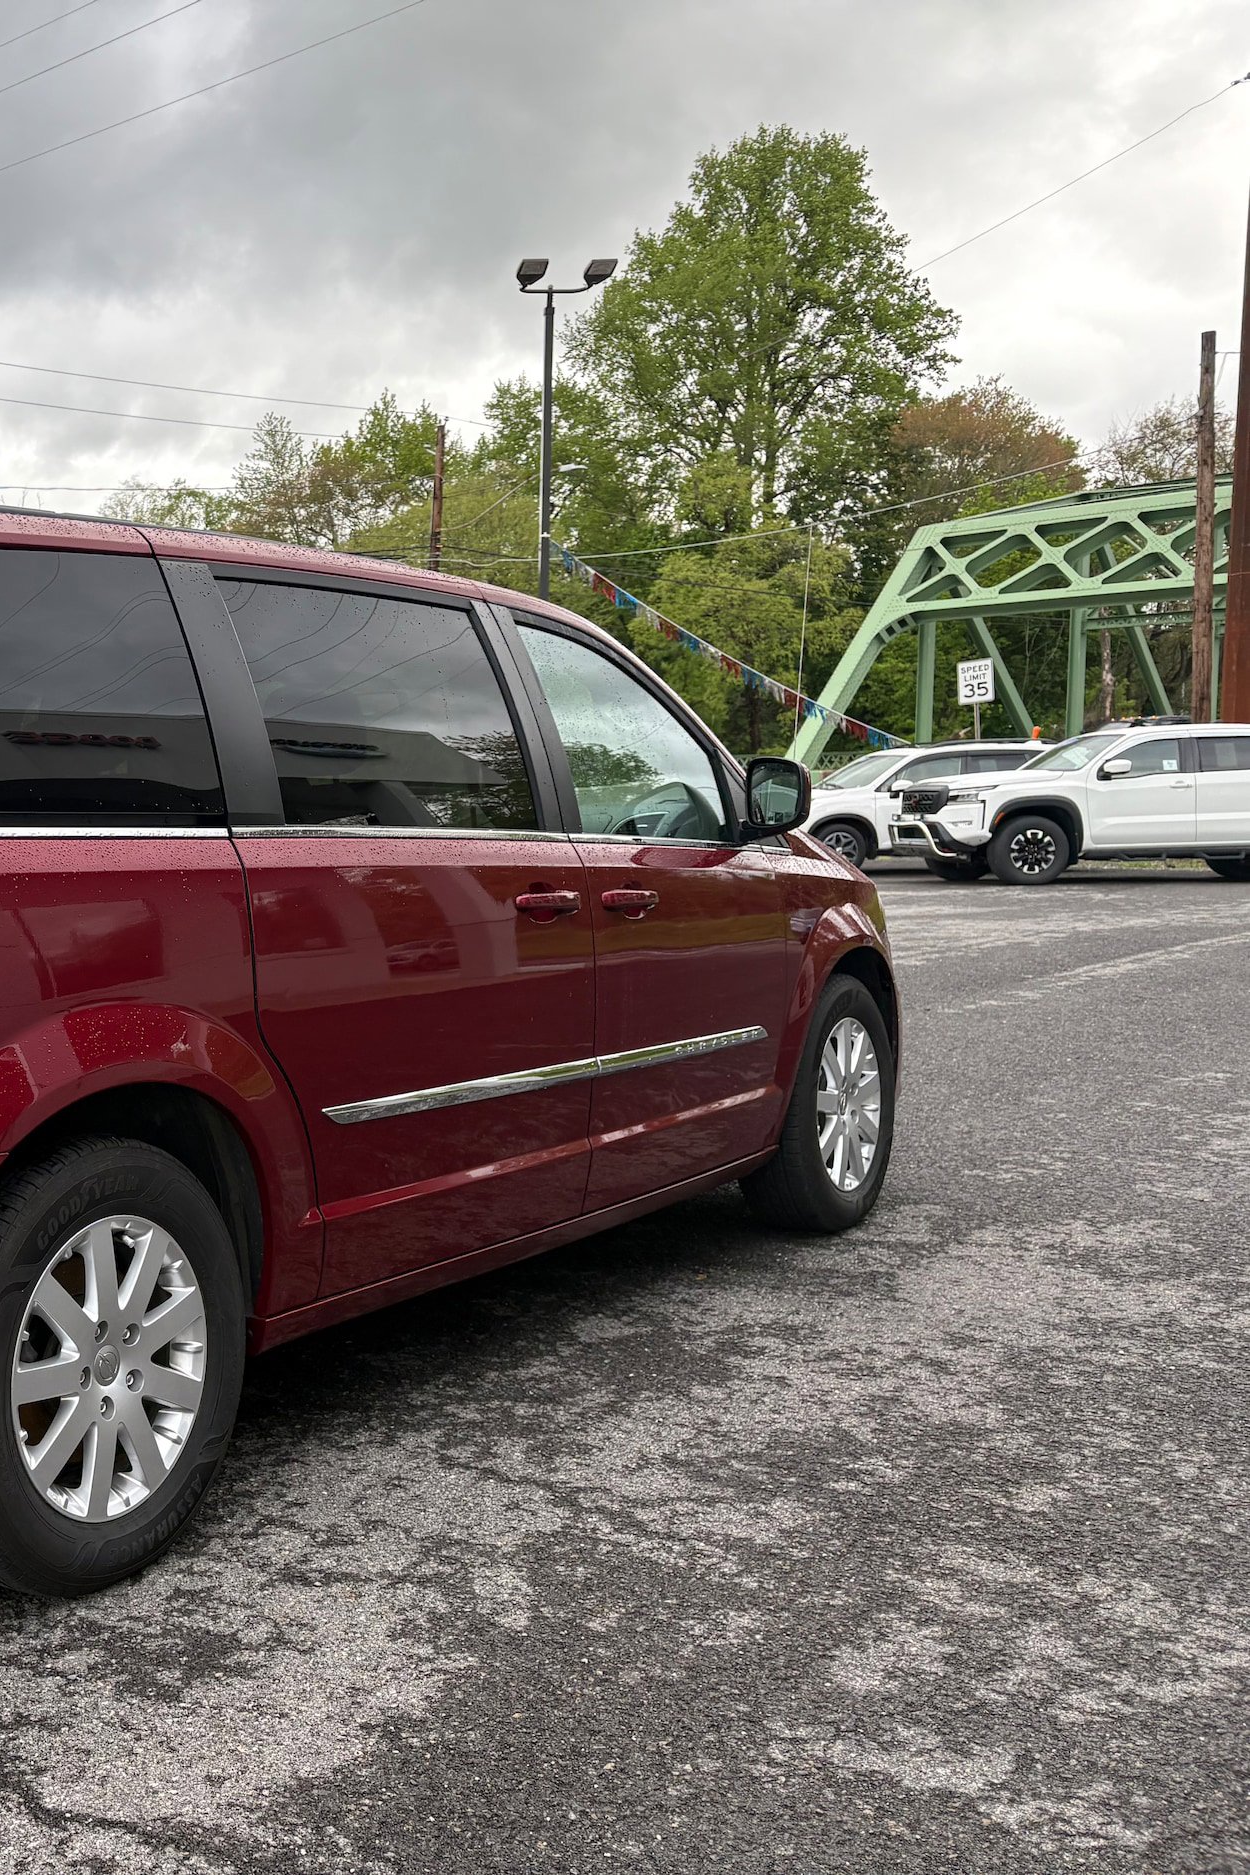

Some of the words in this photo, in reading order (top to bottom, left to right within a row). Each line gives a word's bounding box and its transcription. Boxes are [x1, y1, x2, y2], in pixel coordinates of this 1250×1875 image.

[961, 664, 989, 674] SPEED
[964, 673, 987, 682] LIMIT
[964, 682, 989, 698] 35
[675, 1030, 759, 1055] CHRYSLER
[37, 1175, 139, 1250] GOODYEAR
